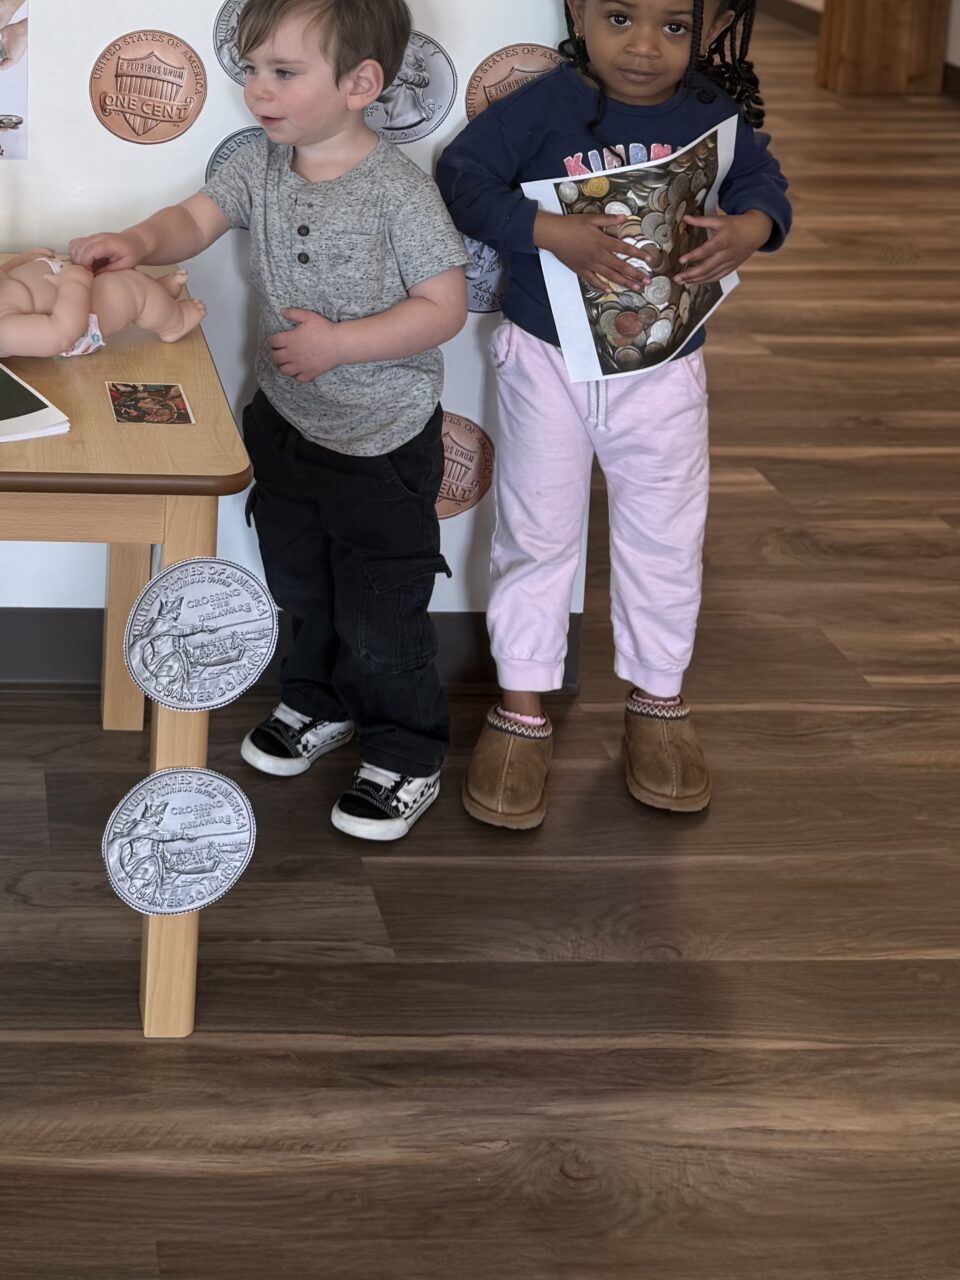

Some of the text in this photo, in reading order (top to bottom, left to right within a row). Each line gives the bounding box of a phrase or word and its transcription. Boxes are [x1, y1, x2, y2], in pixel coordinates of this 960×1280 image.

[105, 94, 187, 119] ONE CENT
[563, 143, 676, 176] KINDN
